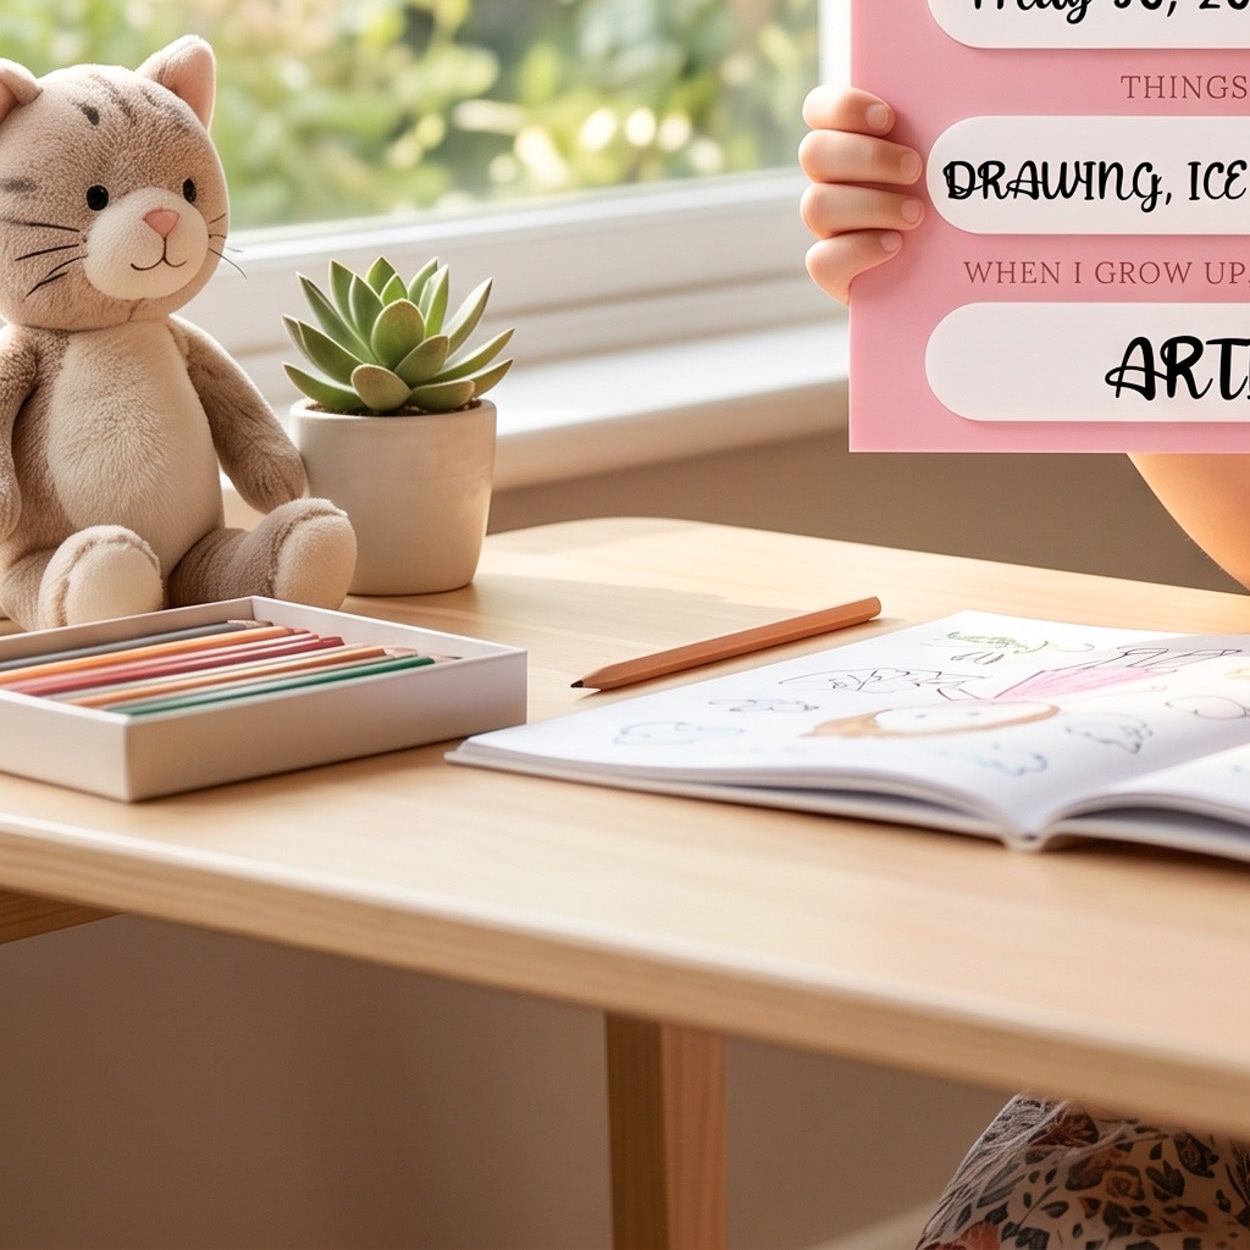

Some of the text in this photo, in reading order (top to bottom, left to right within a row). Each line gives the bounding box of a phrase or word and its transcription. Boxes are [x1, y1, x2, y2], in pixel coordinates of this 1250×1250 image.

[1121, 75, 1248, 99] THINGS
[943, 160, 1173, 212] DRAWING,
[1188, 160, 1247, 200] ICE
[963, 261, 1061, 284] WHEN
[1073, 261, 1082, 285] I
[1095, 261, 1193, 284] GROW
